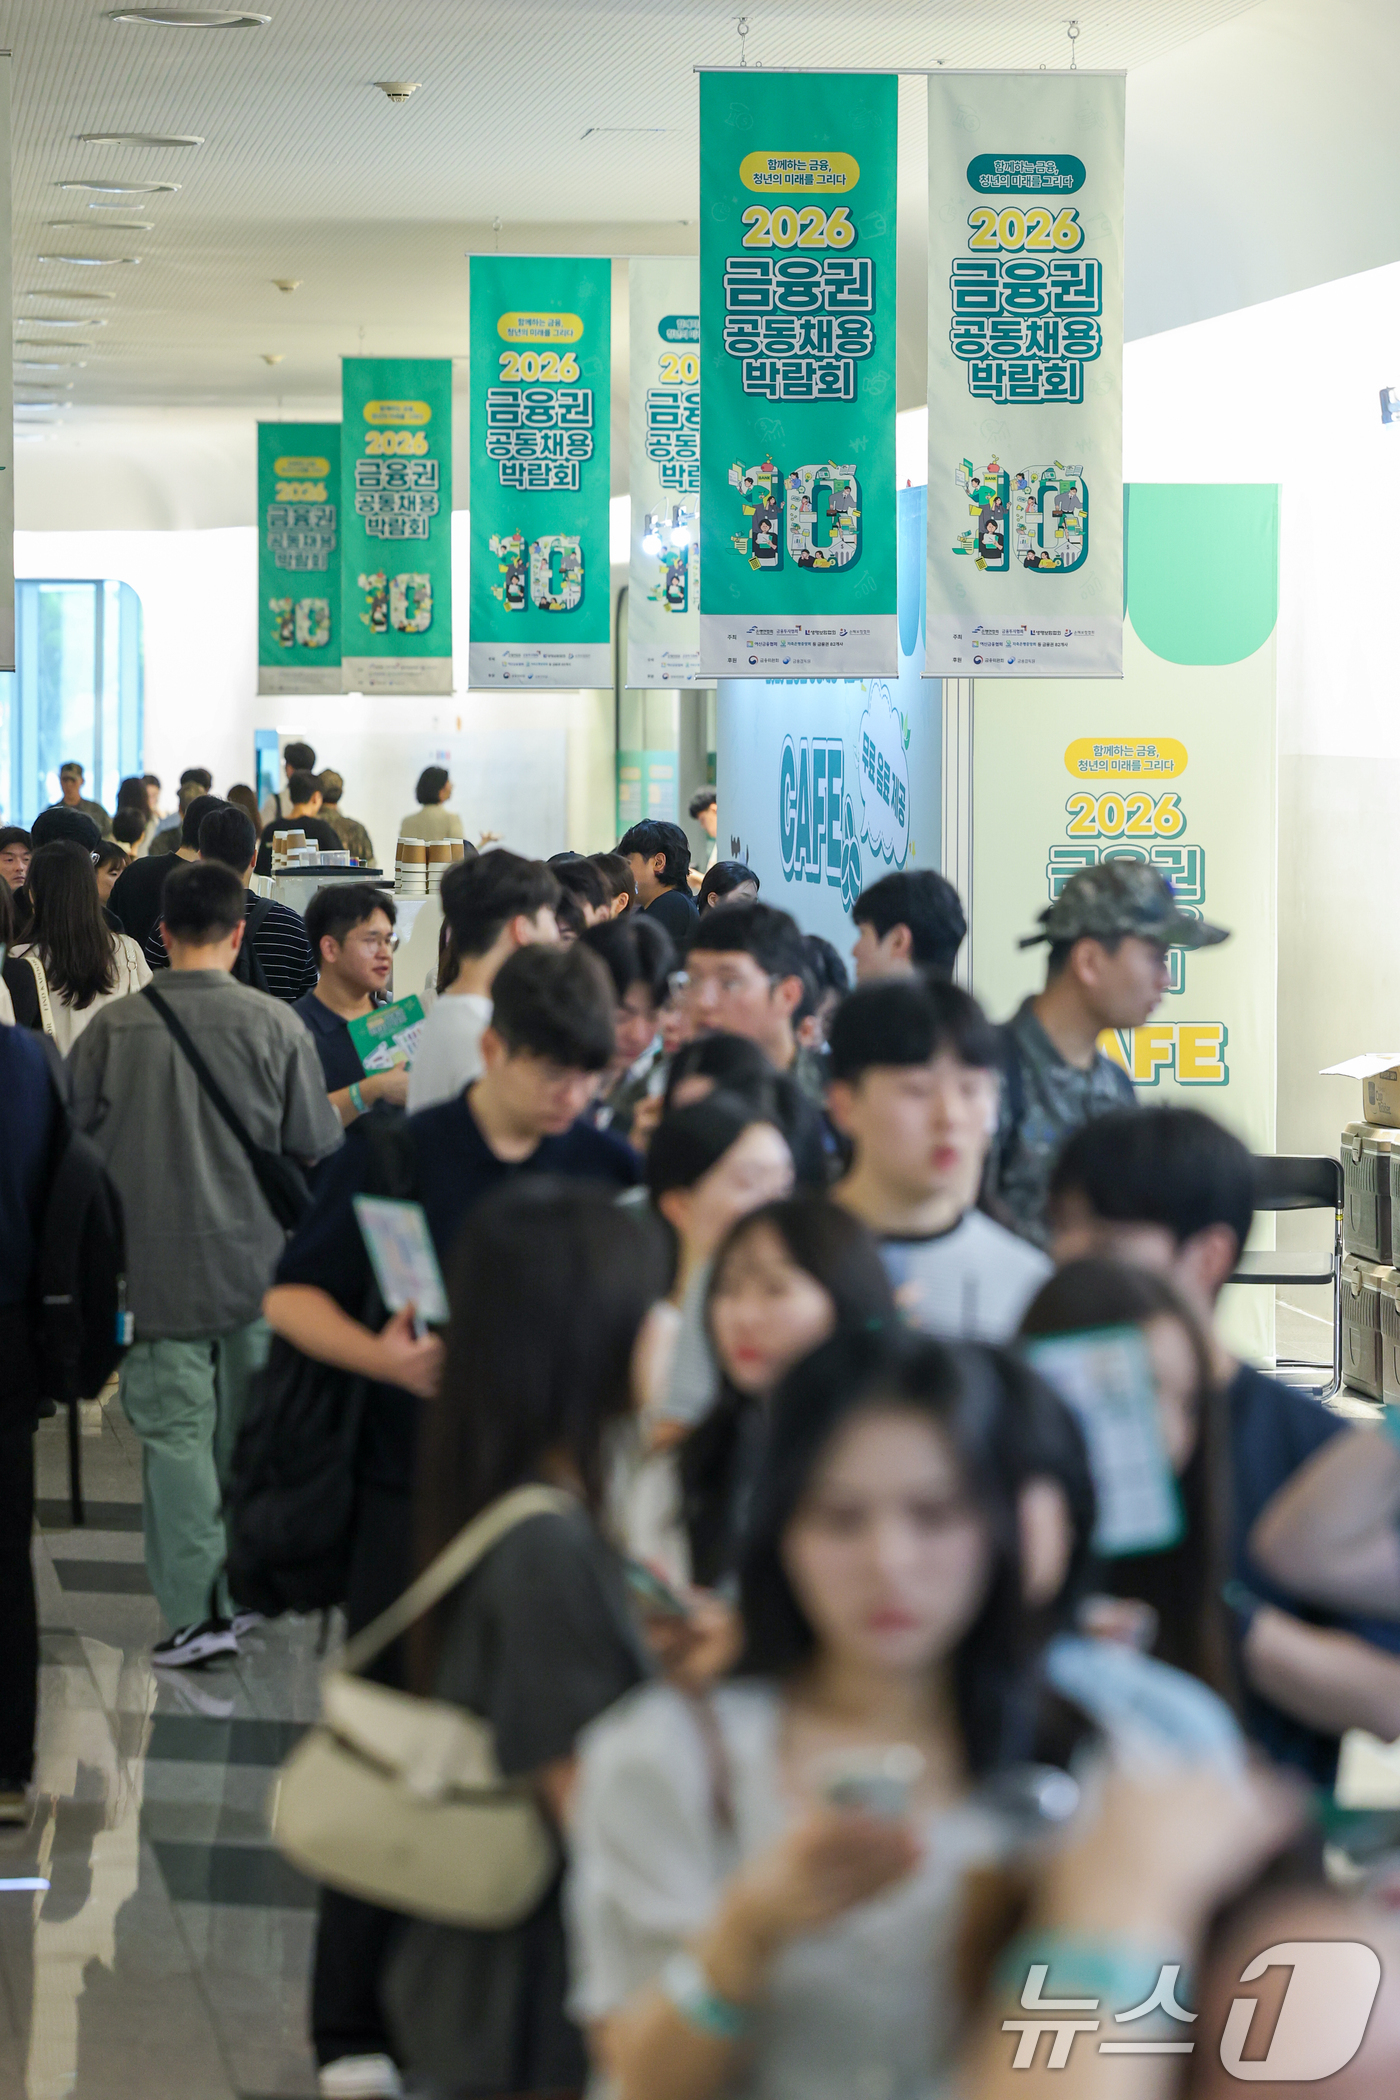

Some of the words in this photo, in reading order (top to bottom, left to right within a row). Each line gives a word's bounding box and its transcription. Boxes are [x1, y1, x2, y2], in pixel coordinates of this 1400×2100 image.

[753, 173, 782, 185] 청년의
[784, 173, 814, 185] 미래를
[816, 173, 846, 186] 그리다
[767, 159, 807, 171] 함께하는
[809, 159, 832, 173] 금융,
[979, 174, 1010, 188] 청년의
[1011, 174, 1042, 188] 미래를
[1042, 174, 1074, 188] 그리다
[994, 160, 1035, 173] 함께하는
[1035, 161, 1059, 175] 금융,
[741, 205, 857, 250] 2026
[967, 206, 1084, 252] 2026
[723, 257, 876, 314] 금융권
[949, 257, 1102, 316] 금융권
[723, 315, 875, 358] 공동채용
[949, 316, 1102, 360] 공동채용
[499, 351, 580, 383] 2026
[742, 358, 857, 402] 박람회
[968, 360, 1083, 404] 박람회
[486, 387, 593, 429] 금융권
[364, 430, 429, 457] 2026
[486, 429, 593, 460] 공동채용
[275, 481, 328, 503] 2026
[355, 459, 439, 491] 금융권
[499, 460, 580, 491] 박람회
[735, 462, 862, 573] 10
[962, 462, 1088, 573] 10
[862, 731, 876, 785] 무료
[876, 752, 891, 806] 음료
[1078, 759, 1109, 772] 청년의
[1111, 759, 1141, 772] 미래를
[1143, 759, 1175, 772] 그리다
[1093, 745, 1134, 757] 함께하는
[1136, 745, 1160, 758] 금융,
[778, 733, 844, 887] CAFE
[1065, 792, 1186, 839] 2026
